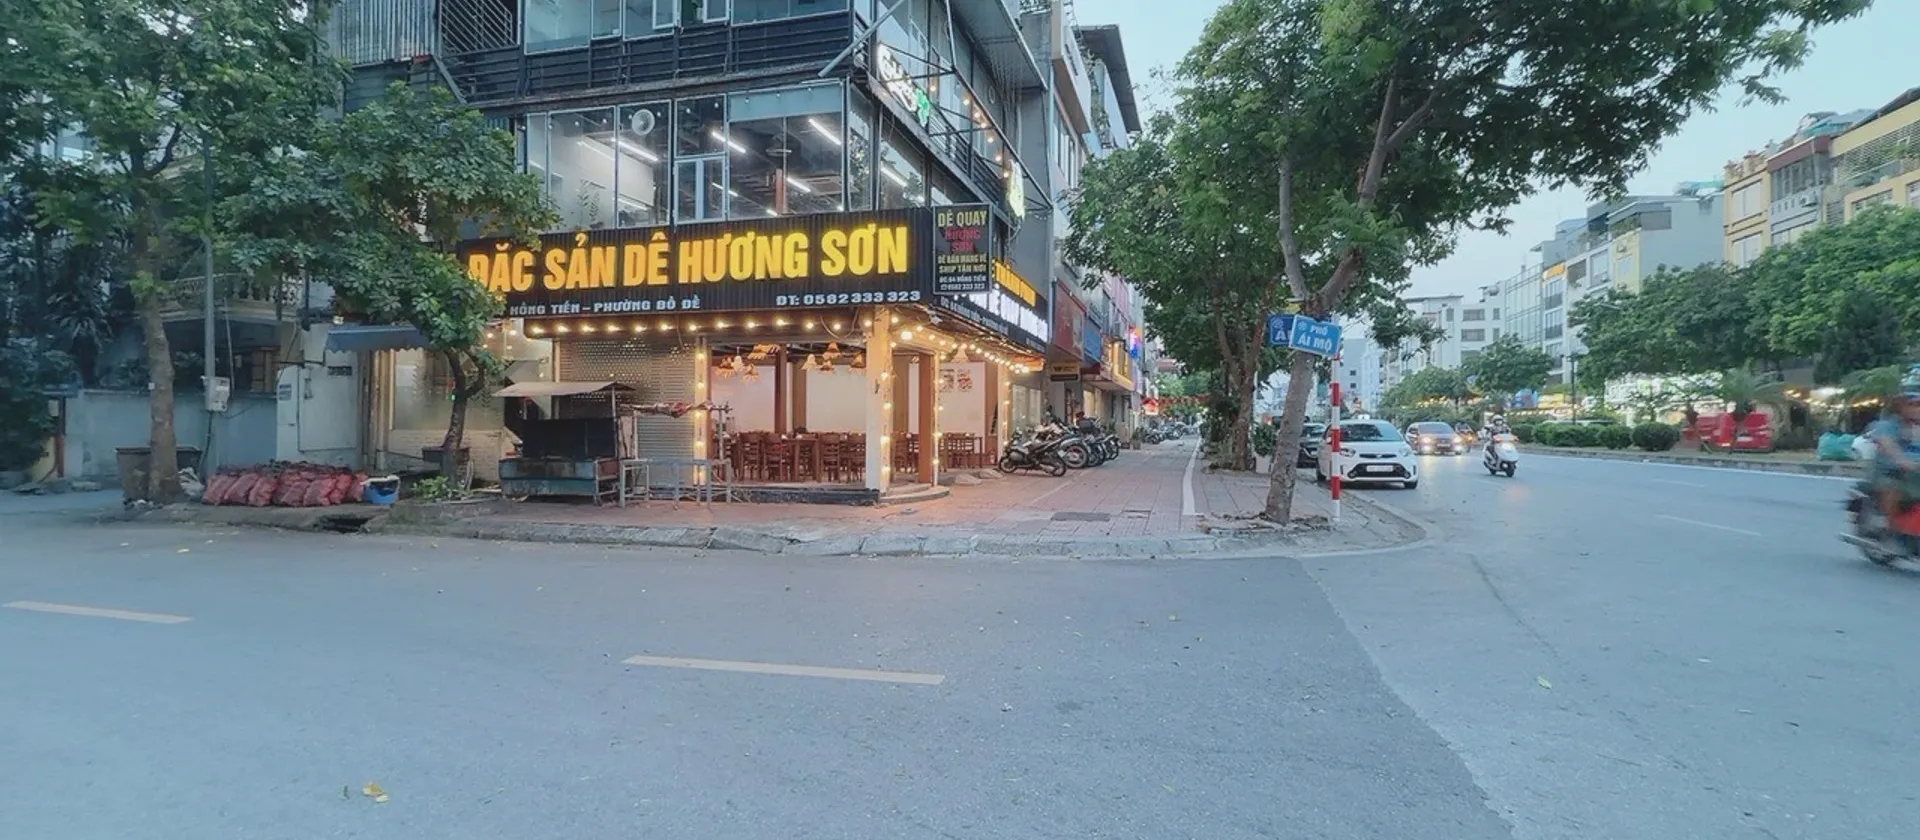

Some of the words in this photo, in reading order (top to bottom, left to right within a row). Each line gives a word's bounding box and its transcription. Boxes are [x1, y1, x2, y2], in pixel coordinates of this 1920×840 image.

[937, 210, 955, 227] DÊ
[956, 211, 987, 227] QUAY
[543, 233, 617, 290] SẢN
[623, 231, 669, 285] DÊ
[678, 230, 809, 284] HƯƠNG
[821, 223, 908, 277] SƠN
[851, 292, 884, 303] 333
[887, 290, 921, 302] 323
[593, 298, 651, 313] PHƯỜNG
